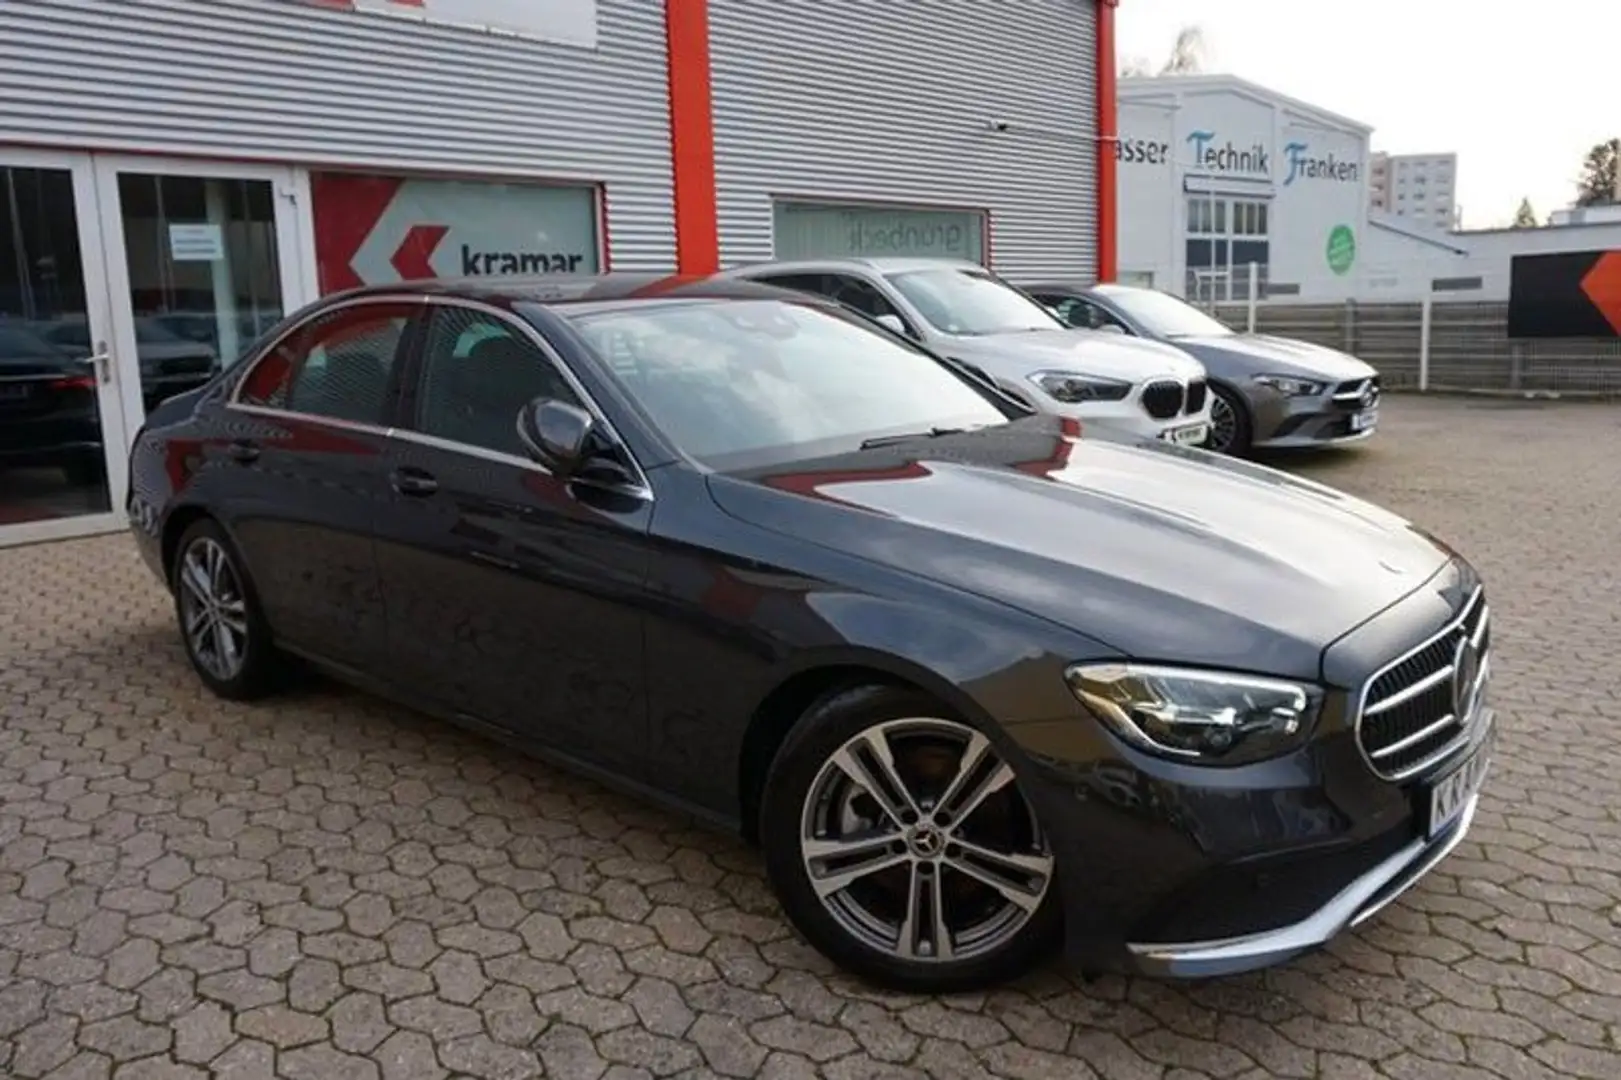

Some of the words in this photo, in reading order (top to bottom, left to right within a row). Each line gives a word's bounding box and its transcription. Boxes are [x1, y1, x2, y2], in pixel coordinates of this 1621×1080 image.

[1186, 129, 1268, 174] Technik
[1283, 141, 1357, 187] Franken
[461, 243, 583, 275] kramar
